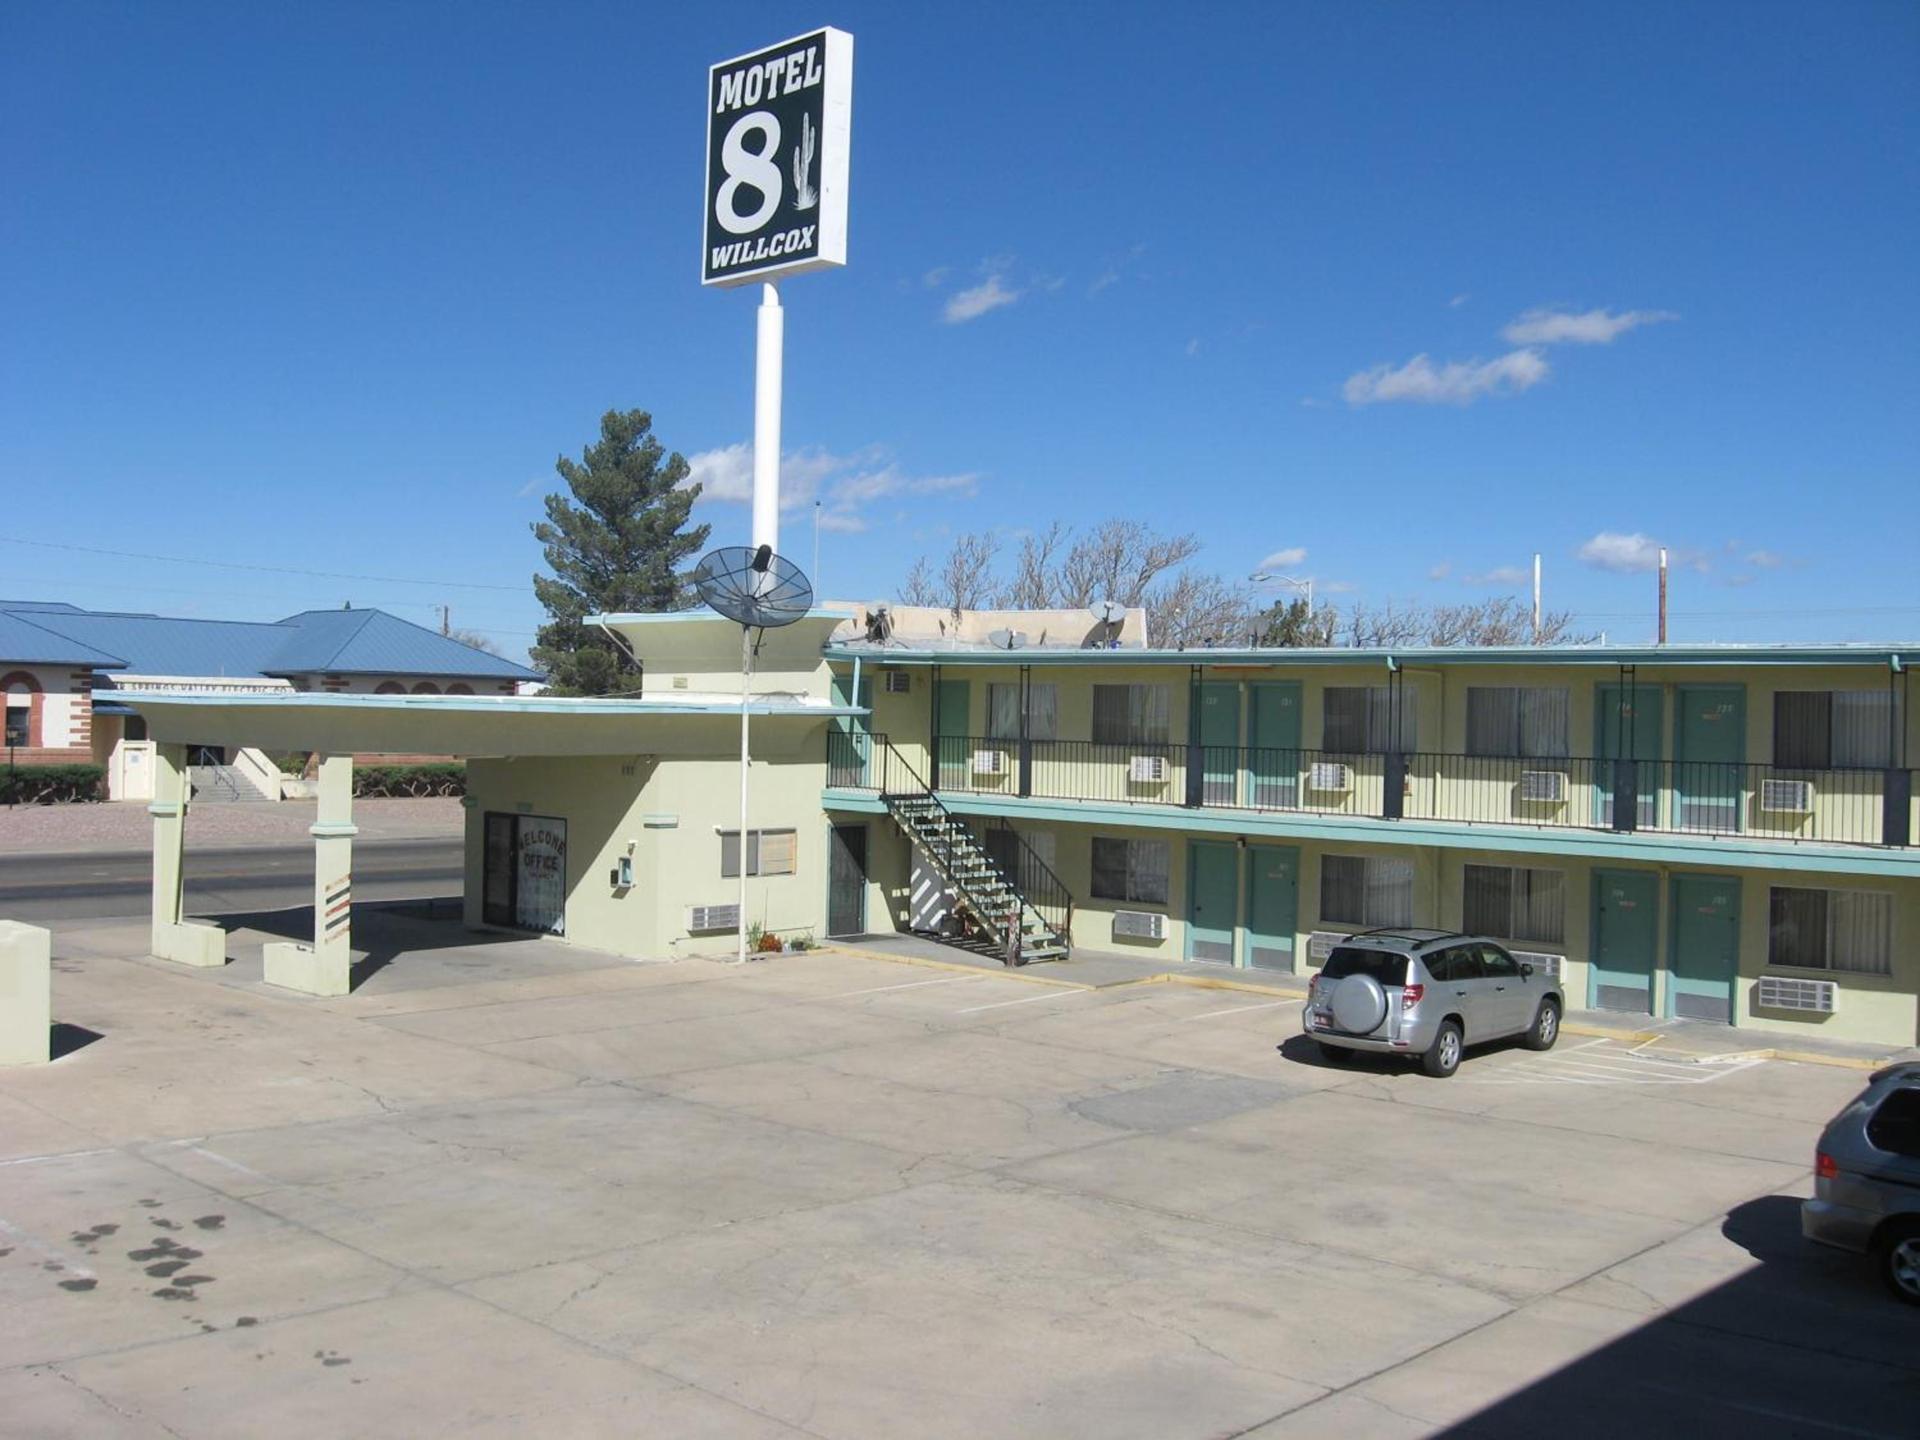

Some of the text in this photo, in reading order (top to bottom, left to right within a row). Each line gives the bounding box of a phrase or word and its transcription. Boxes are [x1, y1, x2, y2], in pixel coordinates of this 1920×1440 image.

[716, 46, 823, 114] MOTEL
[715, 110, 783, 234] 8
[711, 224, 816, 270] WILLCOX
[524, 853, 559, 870] OFFICE
